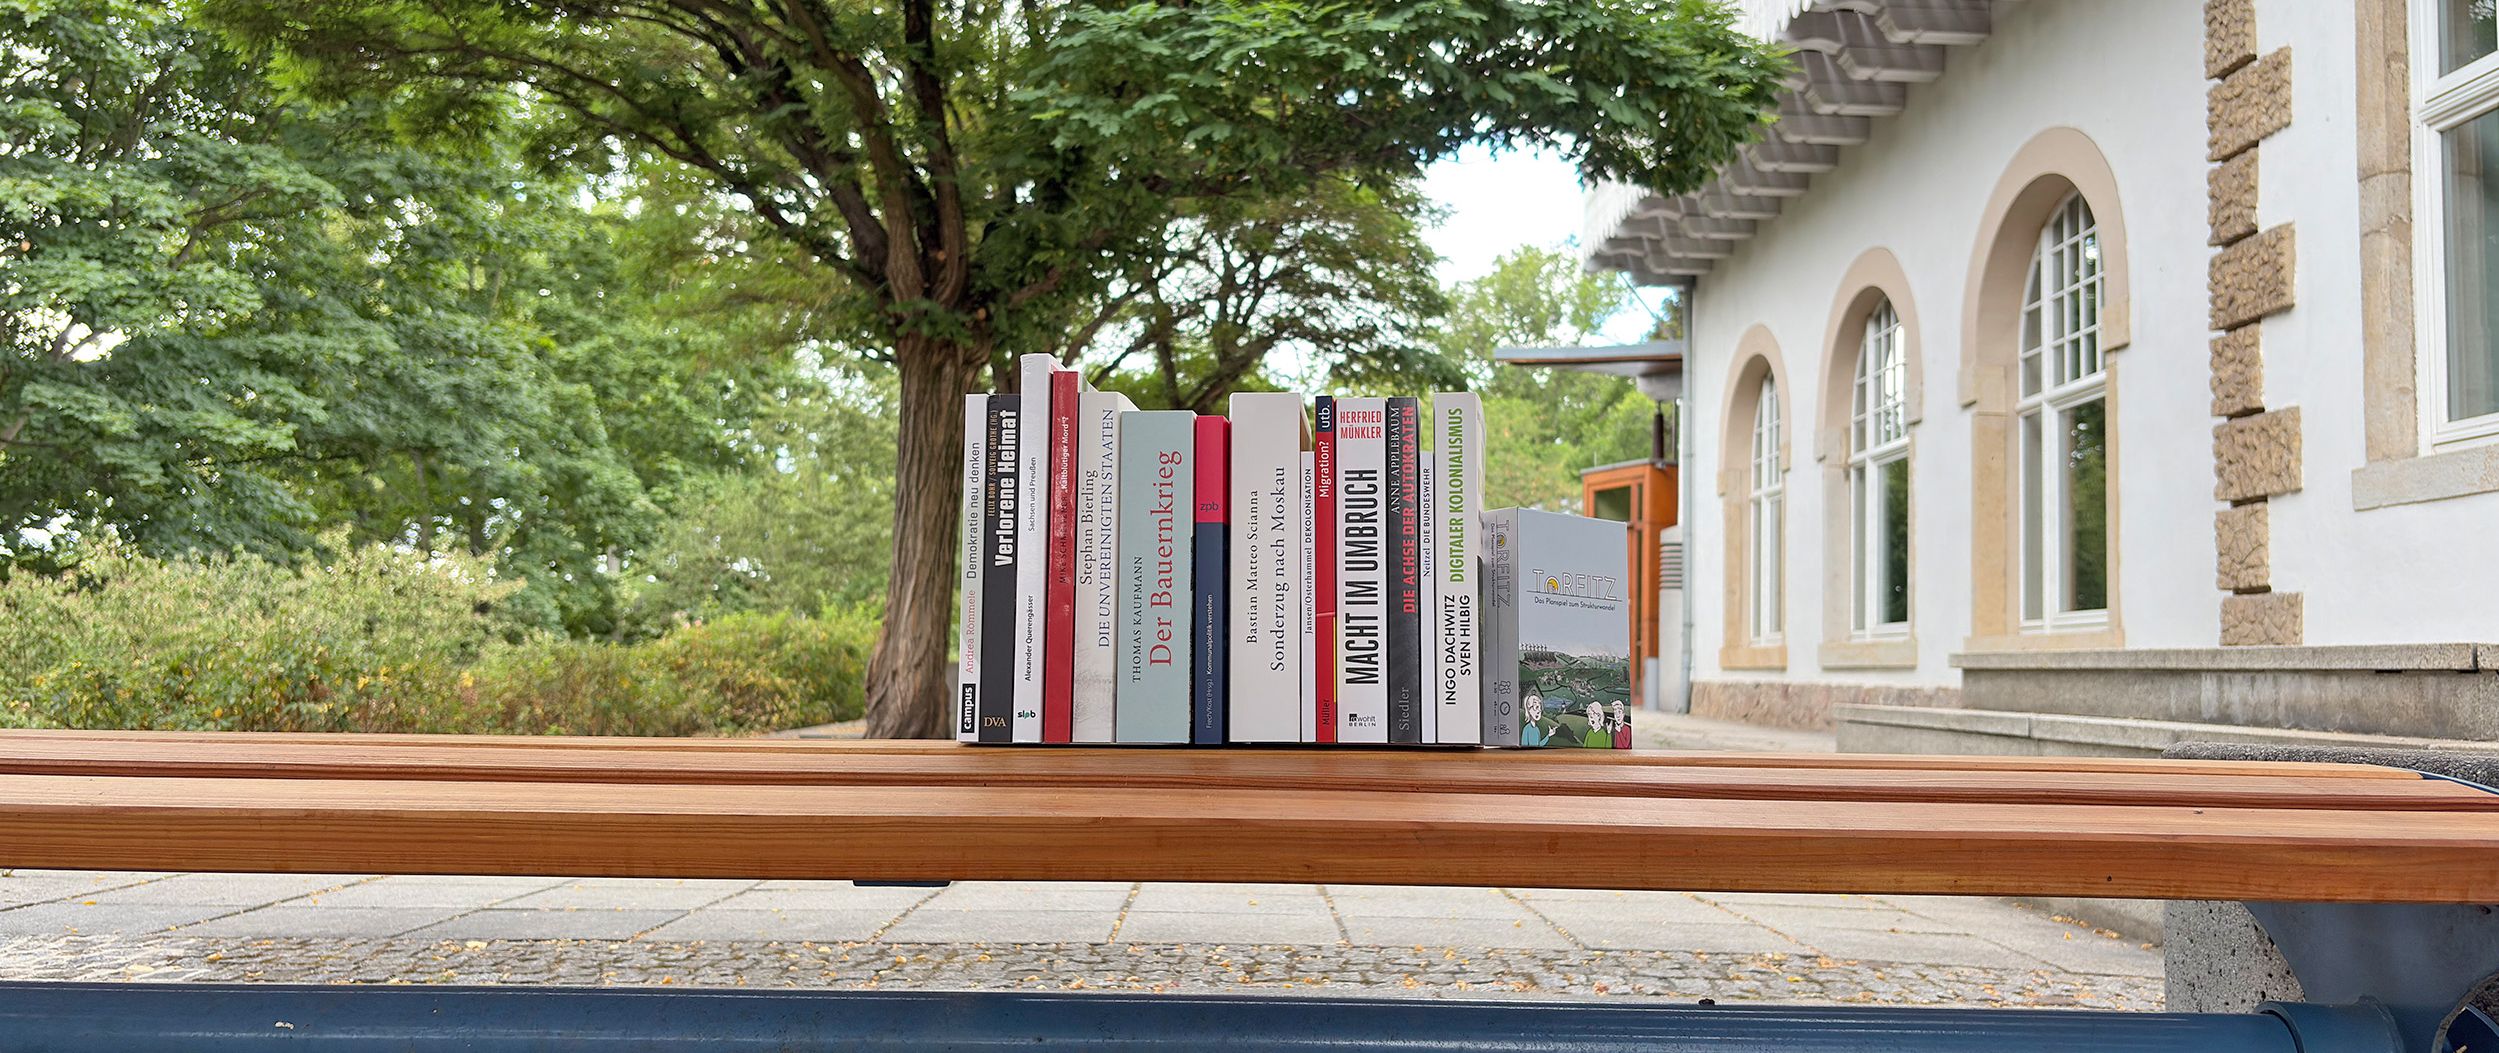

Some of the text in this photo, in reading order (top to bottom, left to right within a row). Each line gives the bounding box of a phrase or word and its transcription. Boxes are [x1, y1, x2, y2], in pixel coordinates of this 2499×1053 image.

[989, 427, 998, 450] GROTHE
[1318, 404, 1331, 428] utb.
[1340, 410, 1382, 424] HERFRIED
[1340, 425, 1382, 439] MÜNKLER
[988, 451, 997, 476] SOLVEIG
[1319, 441, 1332, 498] Migration?
[1391, 407, 1400, 514] ANNE APPLEBAUM
[966, 442, 980, 579] Demokratie neu denken
[987, 502, 996, 517] FELIX
[995, 409, 1017, 567] Verlorene Heimat
[1200, 501, 1219, 513] zpb
[1402, 406, 1416, 614] DIE ACHSE DER AUTOKRATEN
[1423, 468, 1431, 527] BUNDESWEHR
[1448, 408, 1465, 583] DIGITALER KOLONIALISMUS
[1028, 500, 1036, 532] Sachsen
[1080, 470, 1099, 585] Stephan Bierling
[1098, 409, 1114, 648] DIE UNVEREINIGTEN STAATEN
[1150, 450, 1182, 666] Der Bauernkrieg
[1246, 490, 1258, 644] Bastian Matteo Scianna
[1270, 467, 1290, 672] Sonderzug nach Moskau
[1304, 468, 1314, 634] Jansen/Osterhammel DEKOLONISATION
[1344, 469, 1379, 684] MACHT IM UMBRUCH
[1423, 547, 1431, 577] Neitzel
[1132, 556, 1143, 683] THOMAS KAUFMANN
[1534, 596, 1545, 604] Das
[1545, 597, 1568, 607] Planspiel
[1580, 600, 1616, 611] Strukturwandel
[965, 638, 975, 674] Andrea
[1206, 624, 1214, 675] Kommunalpolitik
[1444, 594, 1457, 705] INGO DACHWITZ
[1459, 594, 1471, 676] SVEN HILBIG
[1024, 644, 1033, 682] Alexander
[963, 687, 974, 730] campus
[984, 717, 1007, 727] DVA
[1322, 699, 1330, 726] Müller
[1399, 687, 1410, 731] Siedler
